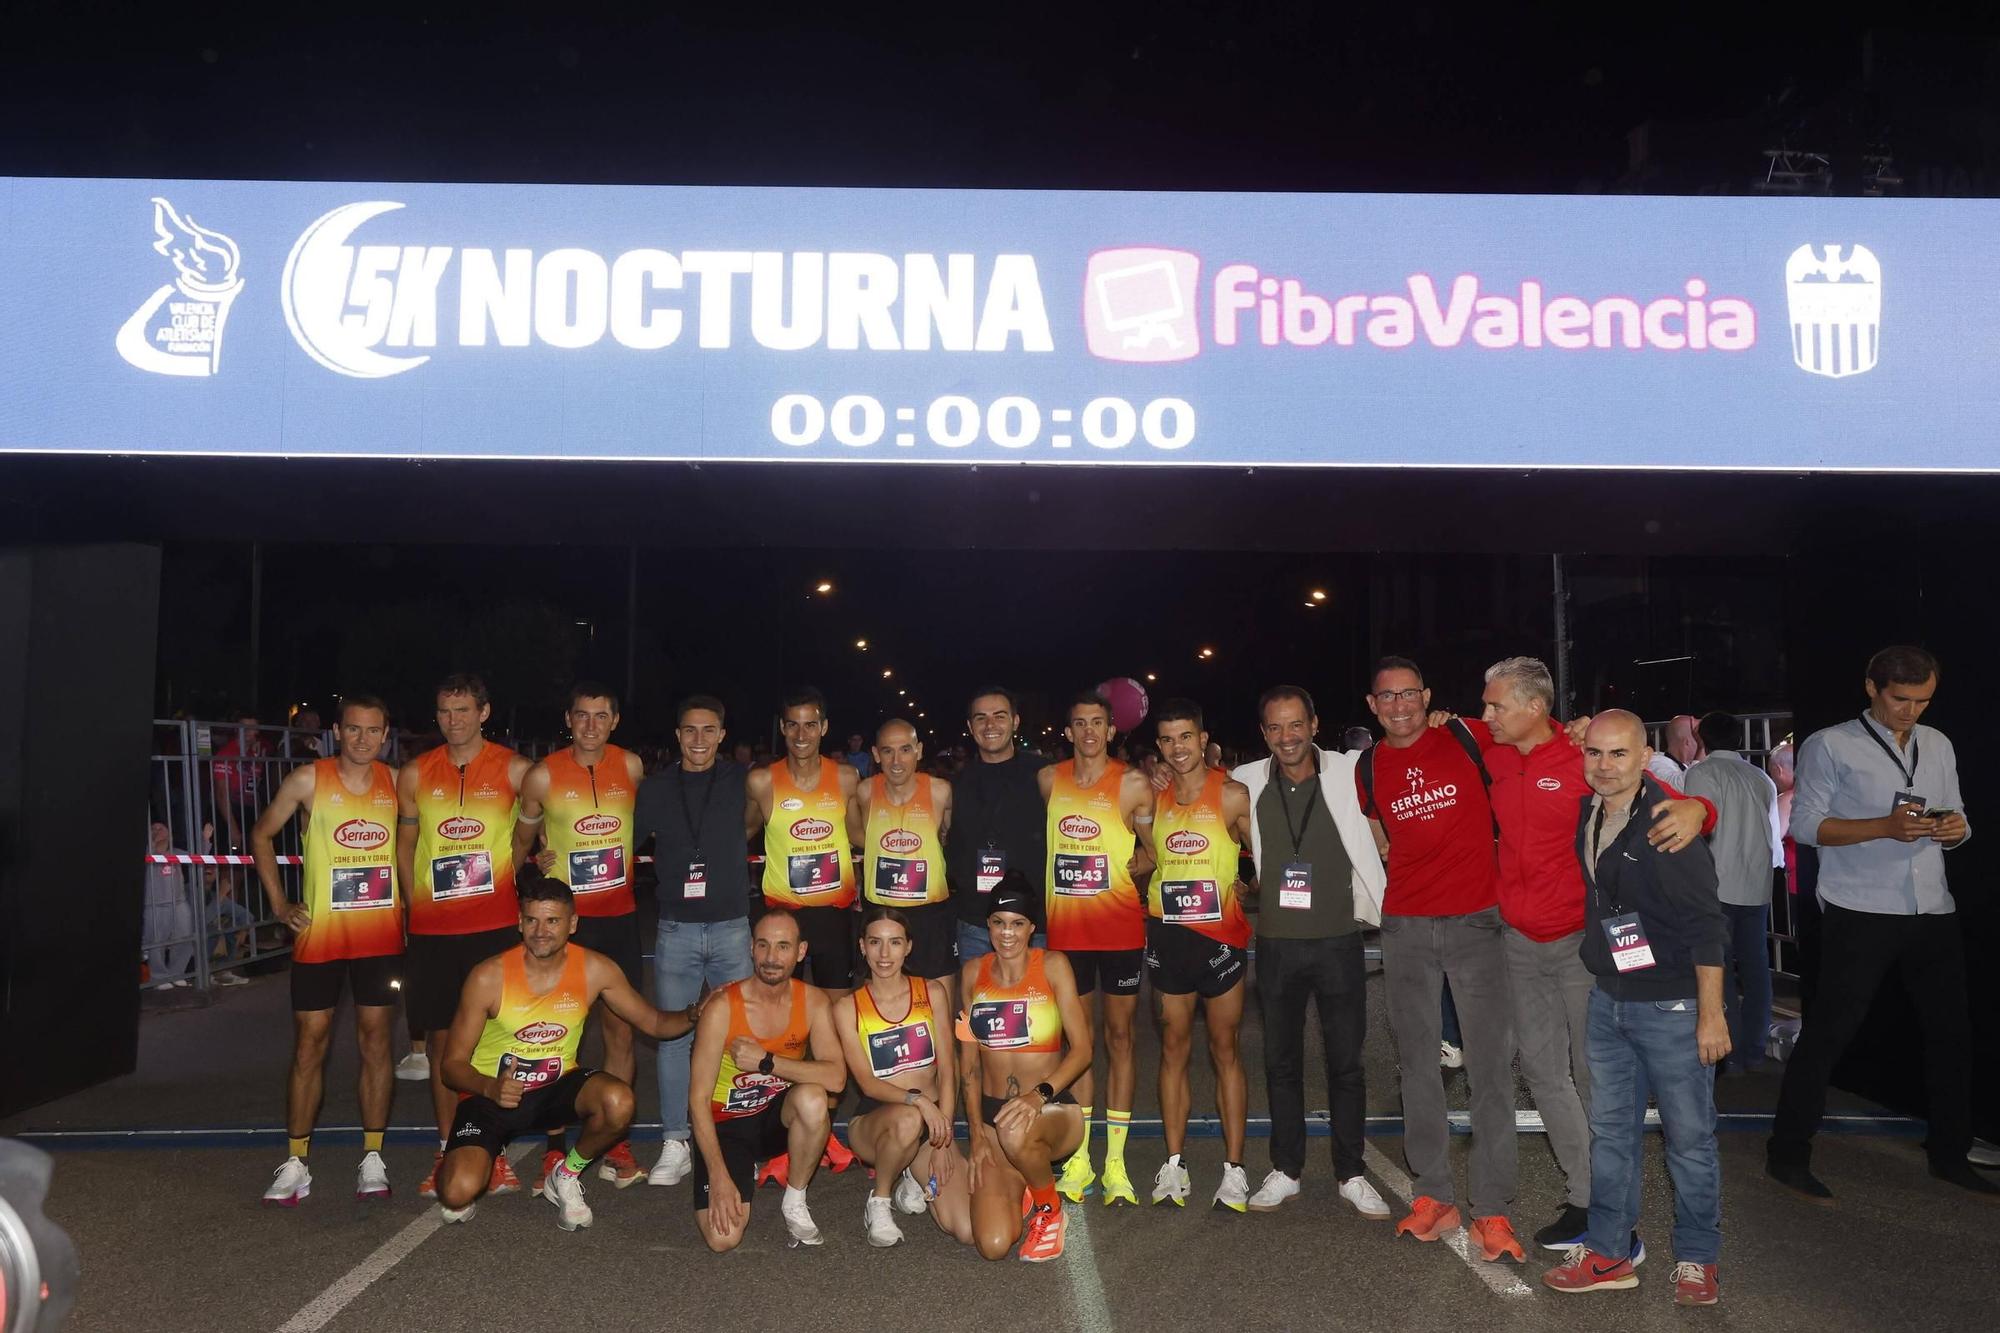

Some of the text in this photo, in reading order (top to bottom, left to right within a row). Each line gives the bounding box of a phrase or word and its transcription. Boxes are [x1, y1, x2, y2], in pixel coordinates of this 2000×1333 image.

[459, 248, 1054, 352] NOCTURNA
[1212, 264, 1757, 351] fibraValencia
[770, 394, 1196, 451] 00:00:00
[1391, 784, 1457, 814] SERRANO
[1397, 798, 1457, 821] CLUB ATLETISMO
[443, 823, 481, 835] Serrano
[580, 819, 618, 832] Serrano
[795, 824, 831, 836] Serrano
[1062, 820, 1098, 834] Serrano
[339, 827, 386, 842] Serrano
[885, 836, 919, 848] Serrano
[1169, 837, 1206, 849] Serrano
[455, 869, 466, 881] 9
[590, 863, 608, 876] 10
[811, 867, 821, 879] 2
[983, 865, 1000, 874] VIP
[1059, 869, 1102, 881] 10543
[690, 872, 703, 881] VIP
[892, 873, 909, 885] 14
[358, 882, 369, 894] 8
[1286, 879, 1306, 889] VIP
[1175, 895, 1202, 907] 103
[1615, 934, 1639, 948] VIP
[987, 1017, 1006, 1031] 12
[520, 1028, 563, 1039] Serrano
[894, 1043, 910, 1058] 11
